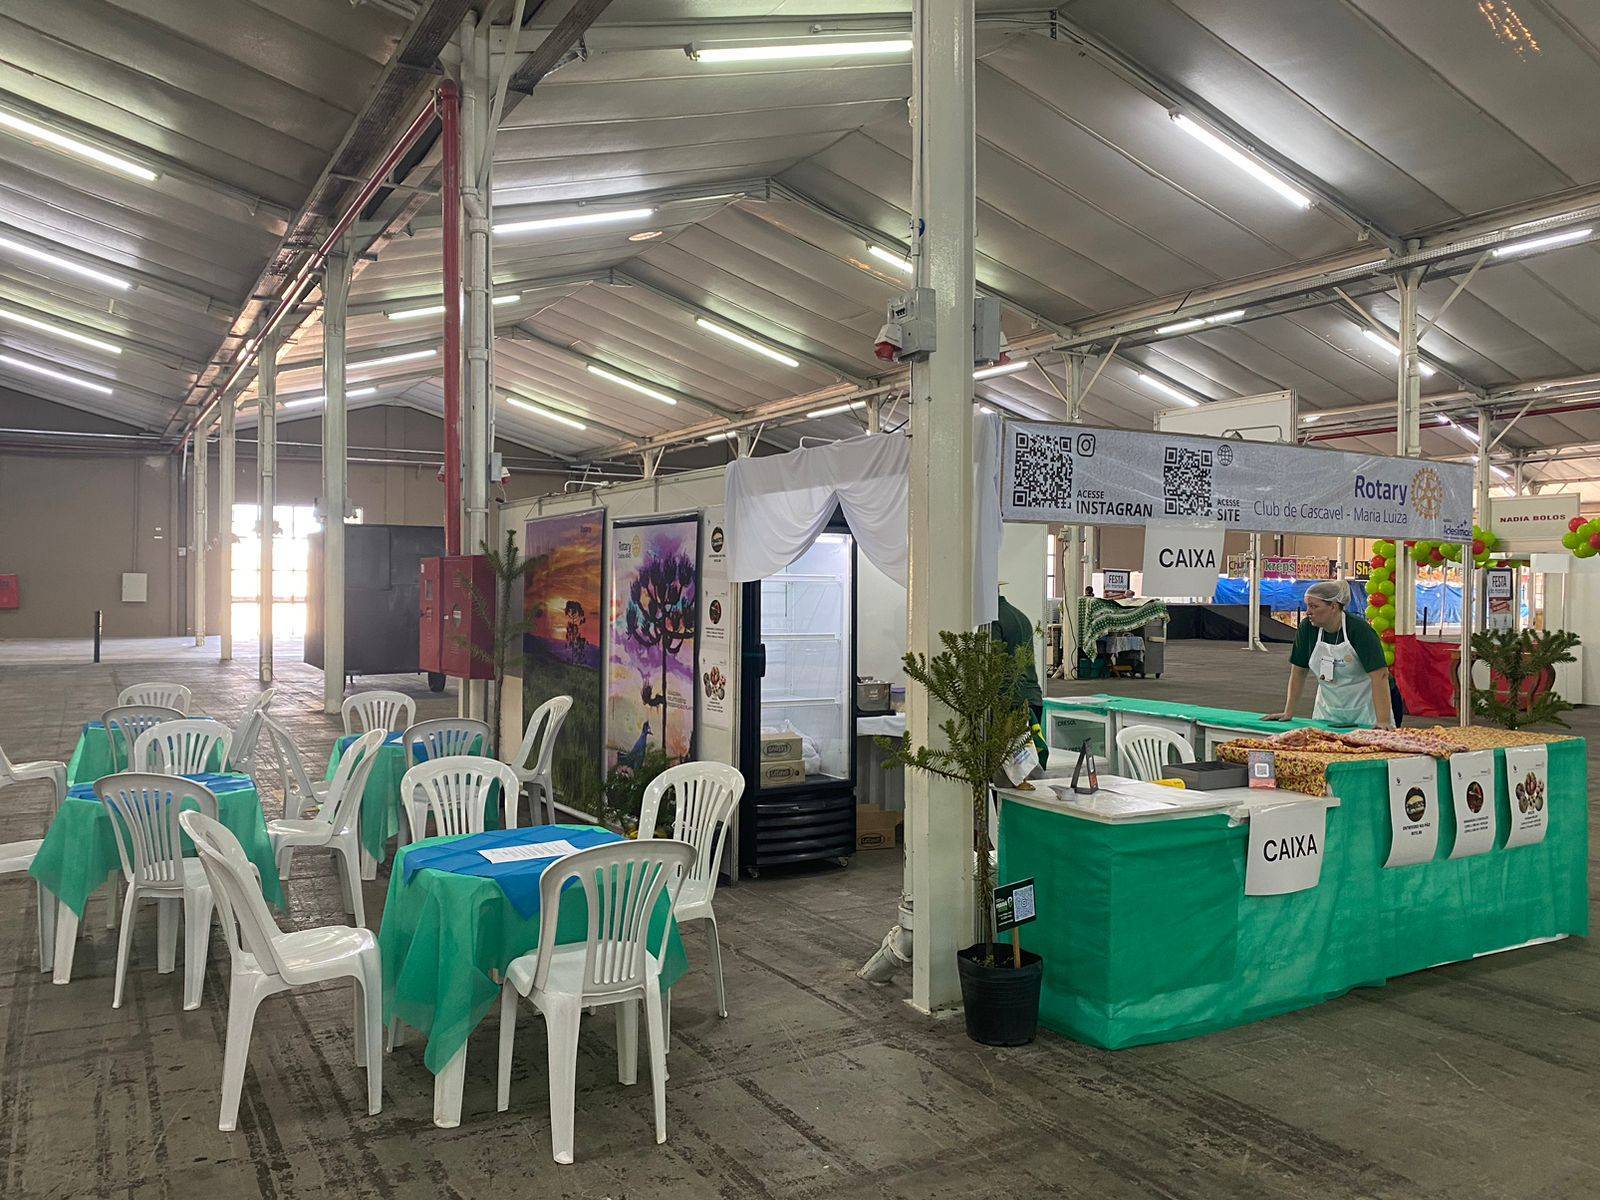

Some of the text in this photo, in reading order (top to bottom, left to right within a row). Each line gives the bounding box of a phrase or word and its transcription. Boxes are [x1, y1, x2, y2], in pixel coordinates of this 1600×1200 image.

[1076, 489, 1105, 499] ACESSE
[1353, 475, 1408, 506] Rotary
[1076, 500, 1153, 518] INSTAGRAN
[1217, 499, 1240, 508] ACESSE
[1217, 508, 1240, 522] SITE
[1253, 500, 1280, 517] Club
[1283, 502, 1298, 518] de
[1300, 503, 1344, 520] Cascavel
[1353, 507, 1381, 523] Maria
[1383, 508, 1408, 525] Luiza
[1532, 514, 1567, 522] BOLOS
[1159, 548, 1216, 568] CAIXA
[1108, 574, 1124, 583] FESTA
[1263, 834, 1318, 862] CAIXA
